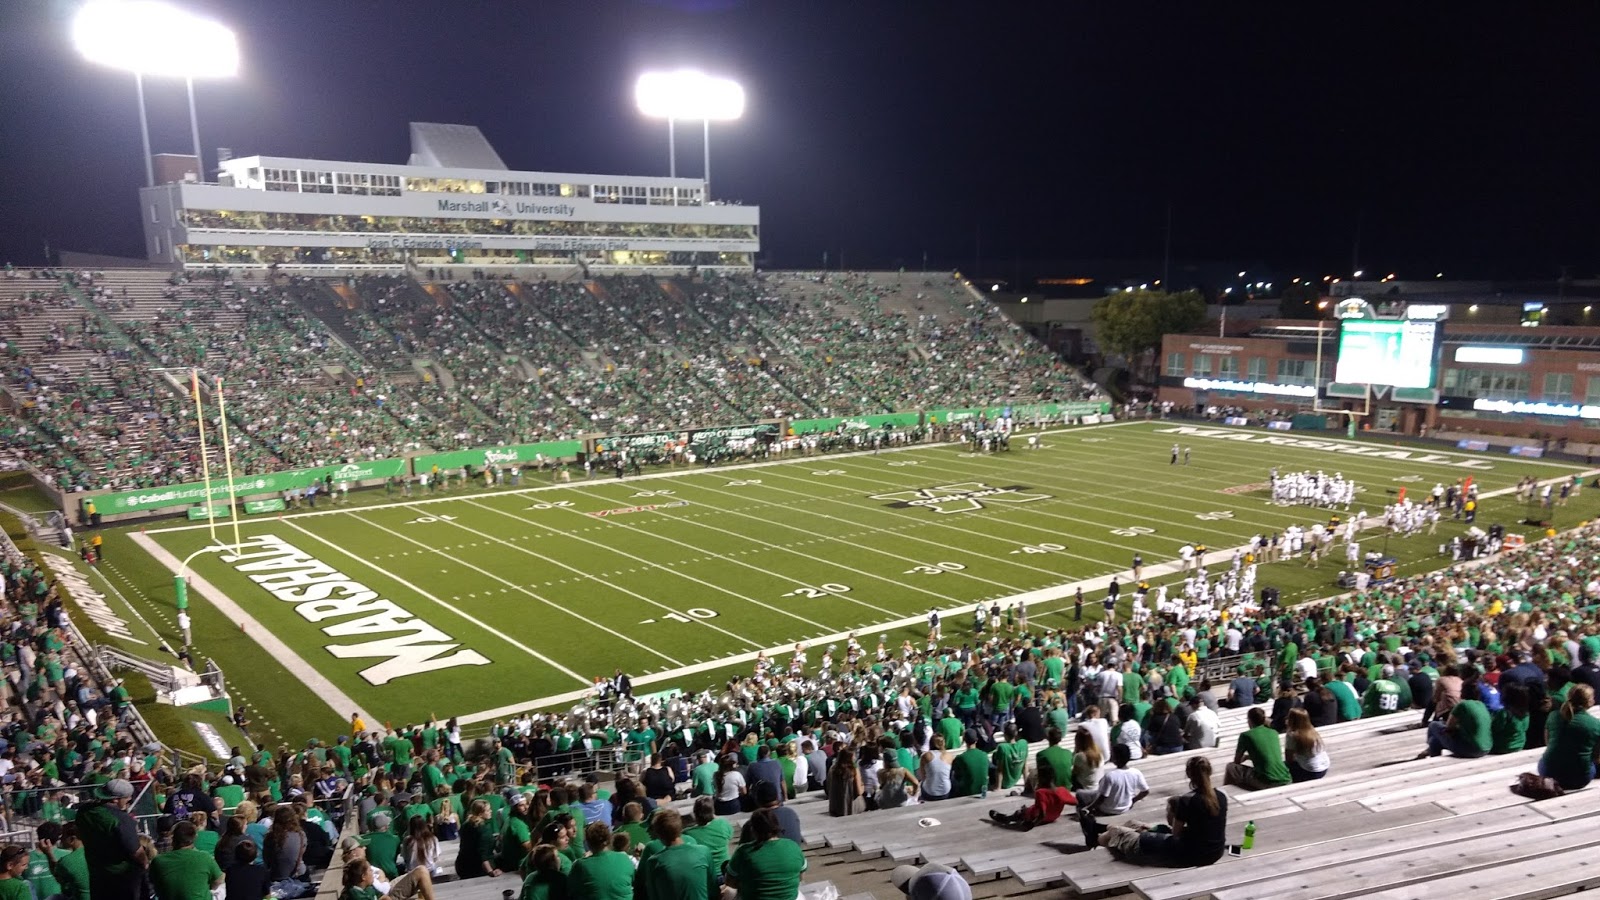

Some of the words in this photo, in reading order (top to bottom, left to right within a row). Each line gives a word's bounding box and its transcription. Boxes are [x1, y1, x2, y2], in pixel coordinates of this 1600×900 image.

[438, 200, 489, 212] Marshall
[516, 202, 575, 216] University
[367, 239, 389, 249] Joan
[403, 239, 442, 249] Edwards
[445, 239, 482, 249] Stadium
[571, 241, 606, 250] Edwards
[608, 241, 629, 250] Field
[1154, 426, 1495, 470] MARSHALL
[139, 491, 174, 504] Cabell
[173, 486, 220, 499] Huntingon
[1109, 526, 1156, 537] 50
[1022, 543, 1068, 554] 40
[913, 561, 967, 575] 30
[794, 583, 851, 599] 20
[218, 533, 496, 687] MARSHALL
[662, 607, 719, 623] 10
